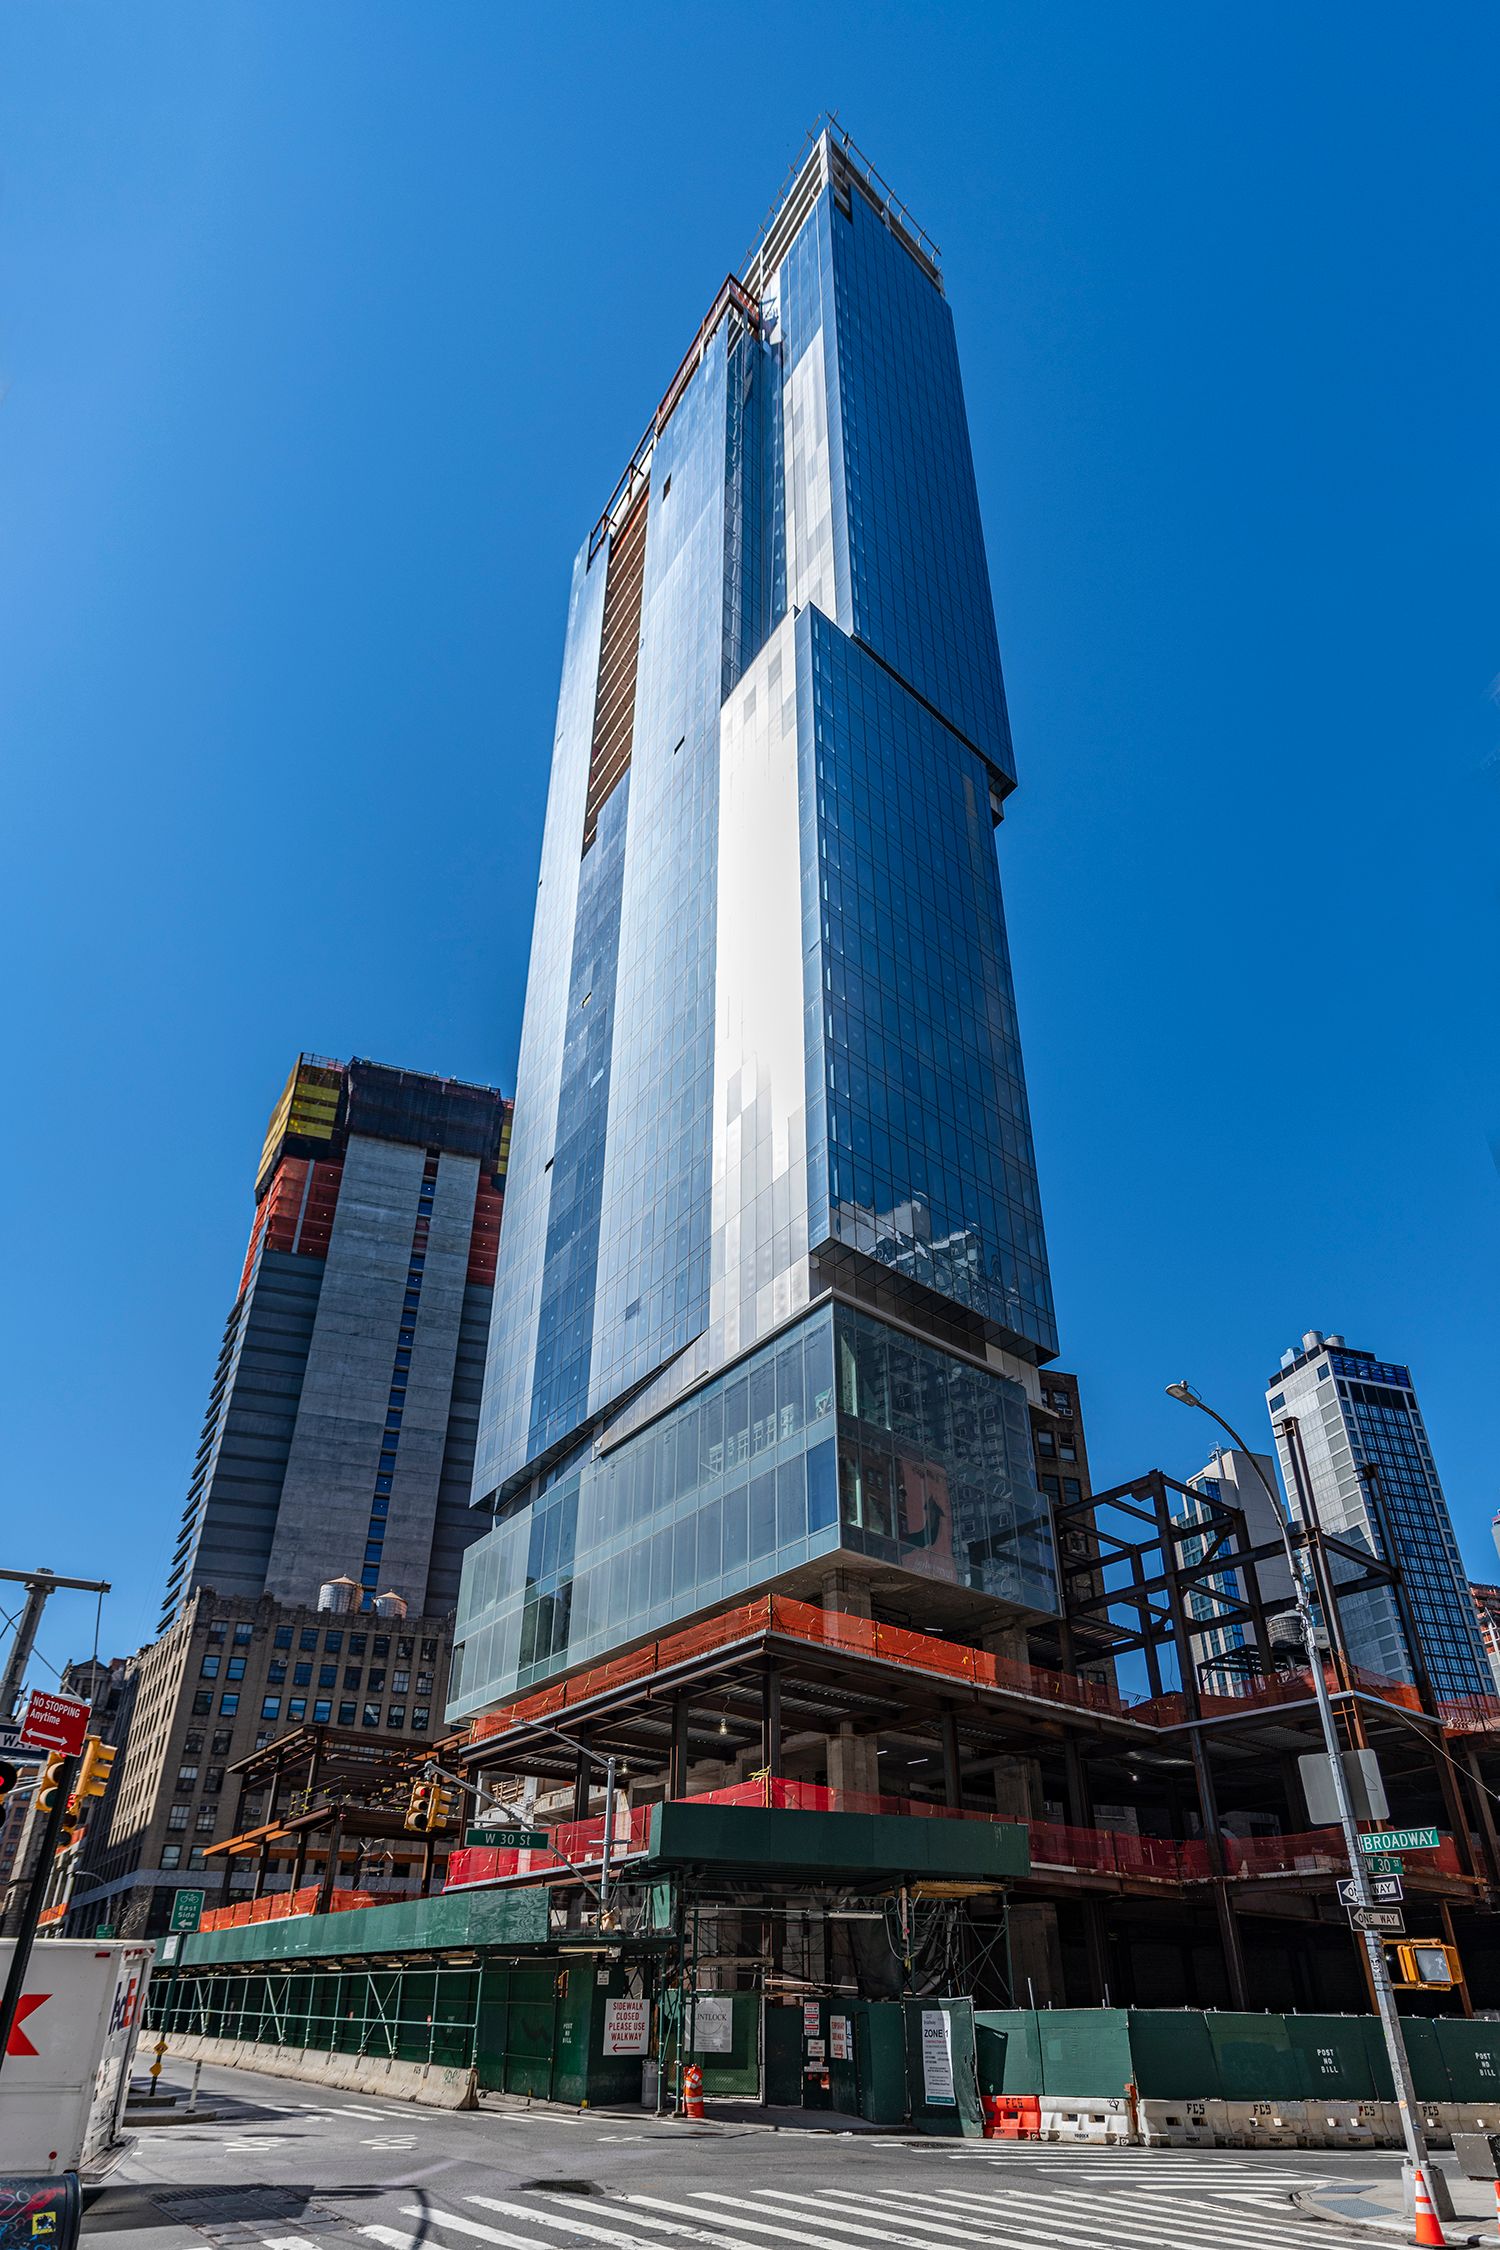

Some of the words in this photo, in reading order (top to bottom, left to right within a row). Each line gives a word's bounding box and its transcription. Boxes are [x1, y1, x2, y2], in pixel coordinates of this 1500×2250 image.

[33, 1696, 44, 1707] NO
[45, 1699, 81, 1718] STOPPING
[30, 1708, 60, 1725] Anytime
[485, 1833, 496, 1844] W
[500, 1834, 515, 1845] 30
[520, 1834, 531, 1846] St
[1363, 1830, 1434, 1851] BROADWAY
[1365, 1857, 1375, 1871] W
[1377, 1858, 1391, 1872] 30
[1372, 1883, 1391, 1894] WAY
[1357, 1912, 1374, 1925] ONE
[1379, 1913, 1396, 1925] WAY
[613, 2002, 644, 2011] SIDEWALK
[615, 2012, 640, 2021] CLOSED
[608, 2022, 632, 2031] PLEASE
[633, 2022, 645, 2031] USE
[611, 2032, 642, 2041] WALKWAY
[924, 2029, 943, 2038] ZONE
[945, 2029, 949, 2038] 1
[1317, 2049, 1334, 2057] POST
[1475, 2052, 1491, 2060] POST
[1323, 2057, 1333, 2065] NO
[1320, 2065, 1339, 2074] BILL
[1479, 2068, 1496, 2077] BILL
[1186, 2103, 1205, 2115] FCS
